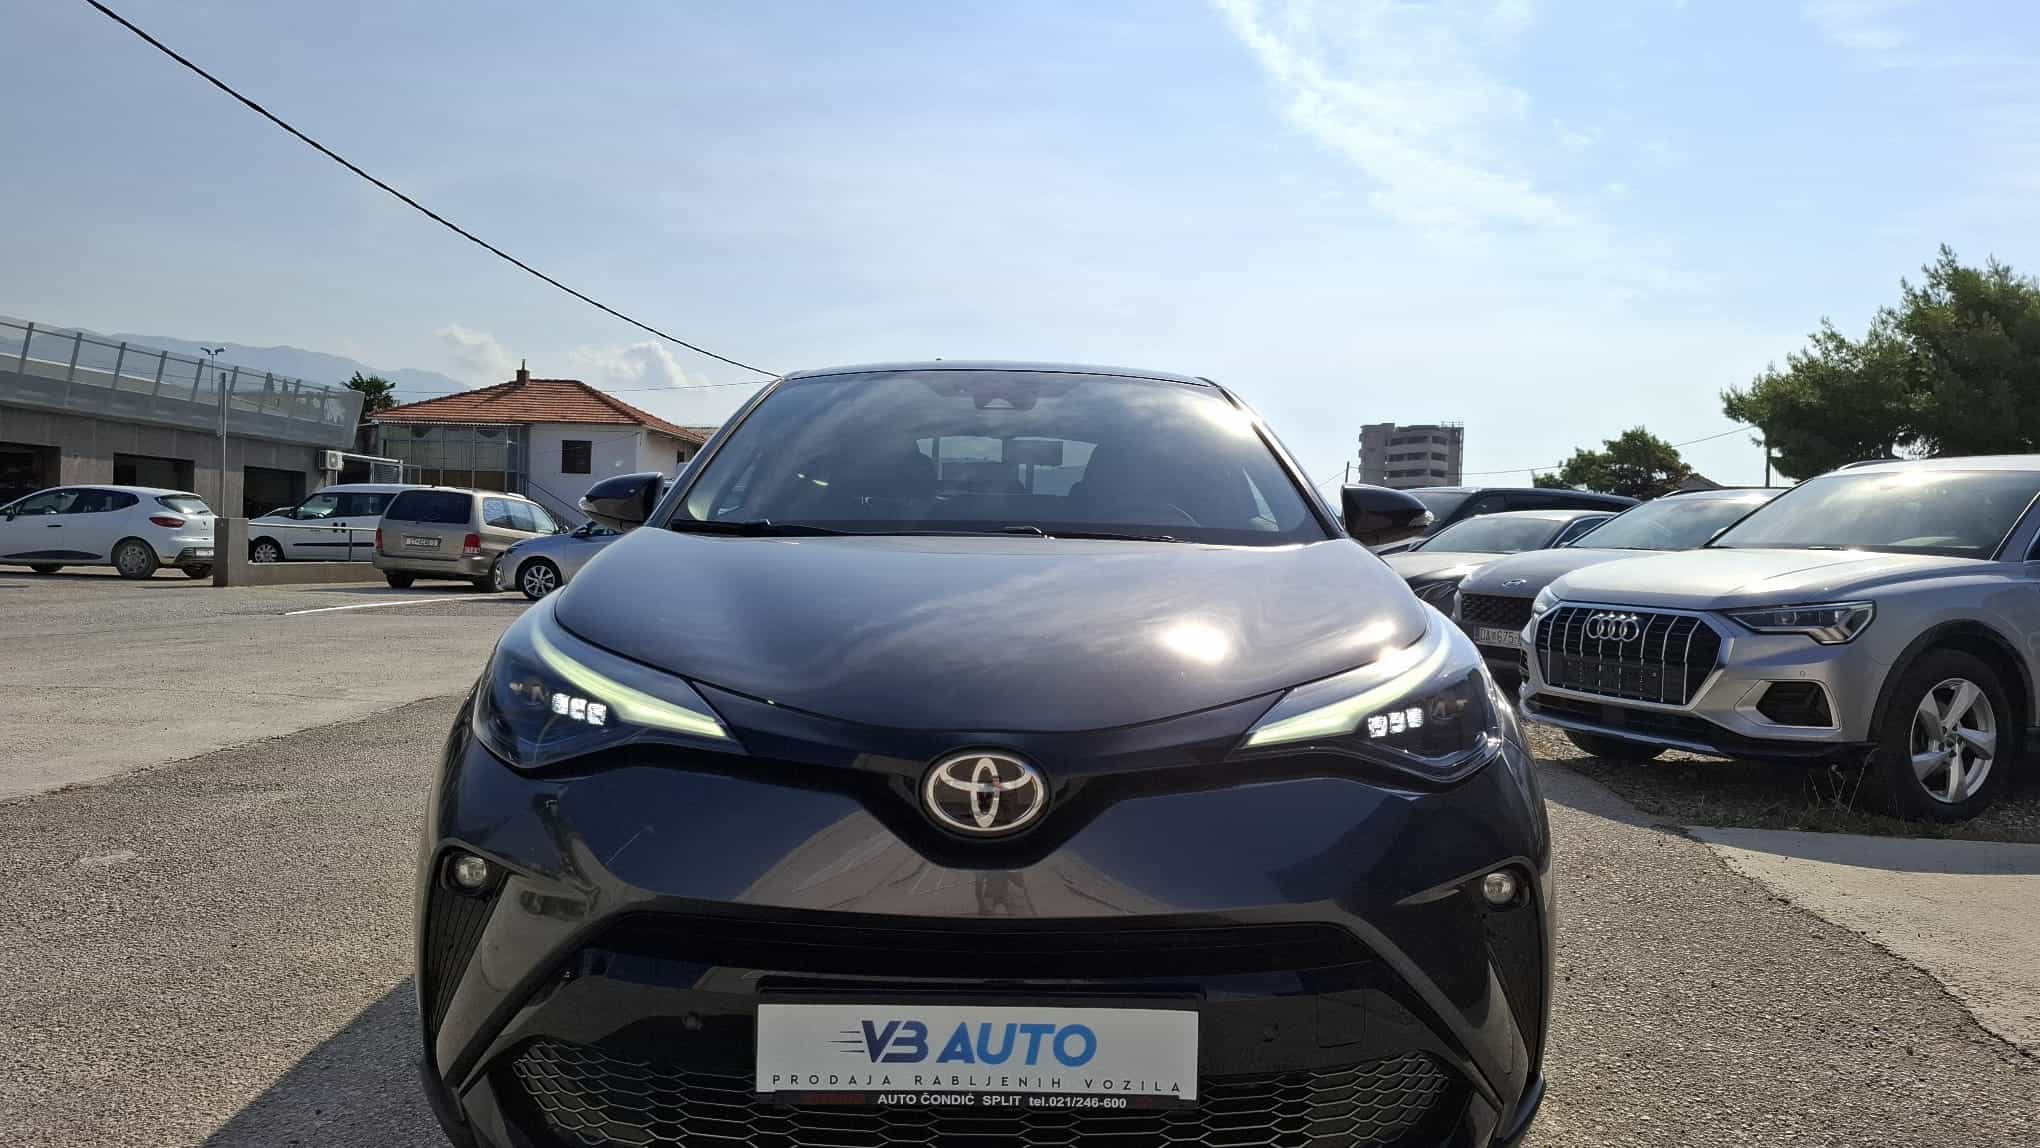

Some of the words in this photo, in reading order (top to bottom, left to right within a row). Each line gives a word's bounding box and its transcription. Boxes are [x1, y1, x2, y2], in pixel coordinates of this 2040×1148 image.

[935, 1020, 1098, 1069] AUTO
[772, 1074, 892, 1086] PRODAJA
[914, 1075, 1062, 1089] RABLJENIH
[1084, 1078, 1181, 1093] VOZILA
[877, 1094, 917, 1105] AUTO
[982, 1095, 1022, 1106] SPLIT
[1029, 1096, 1127, 1109] tel.021/246-600
